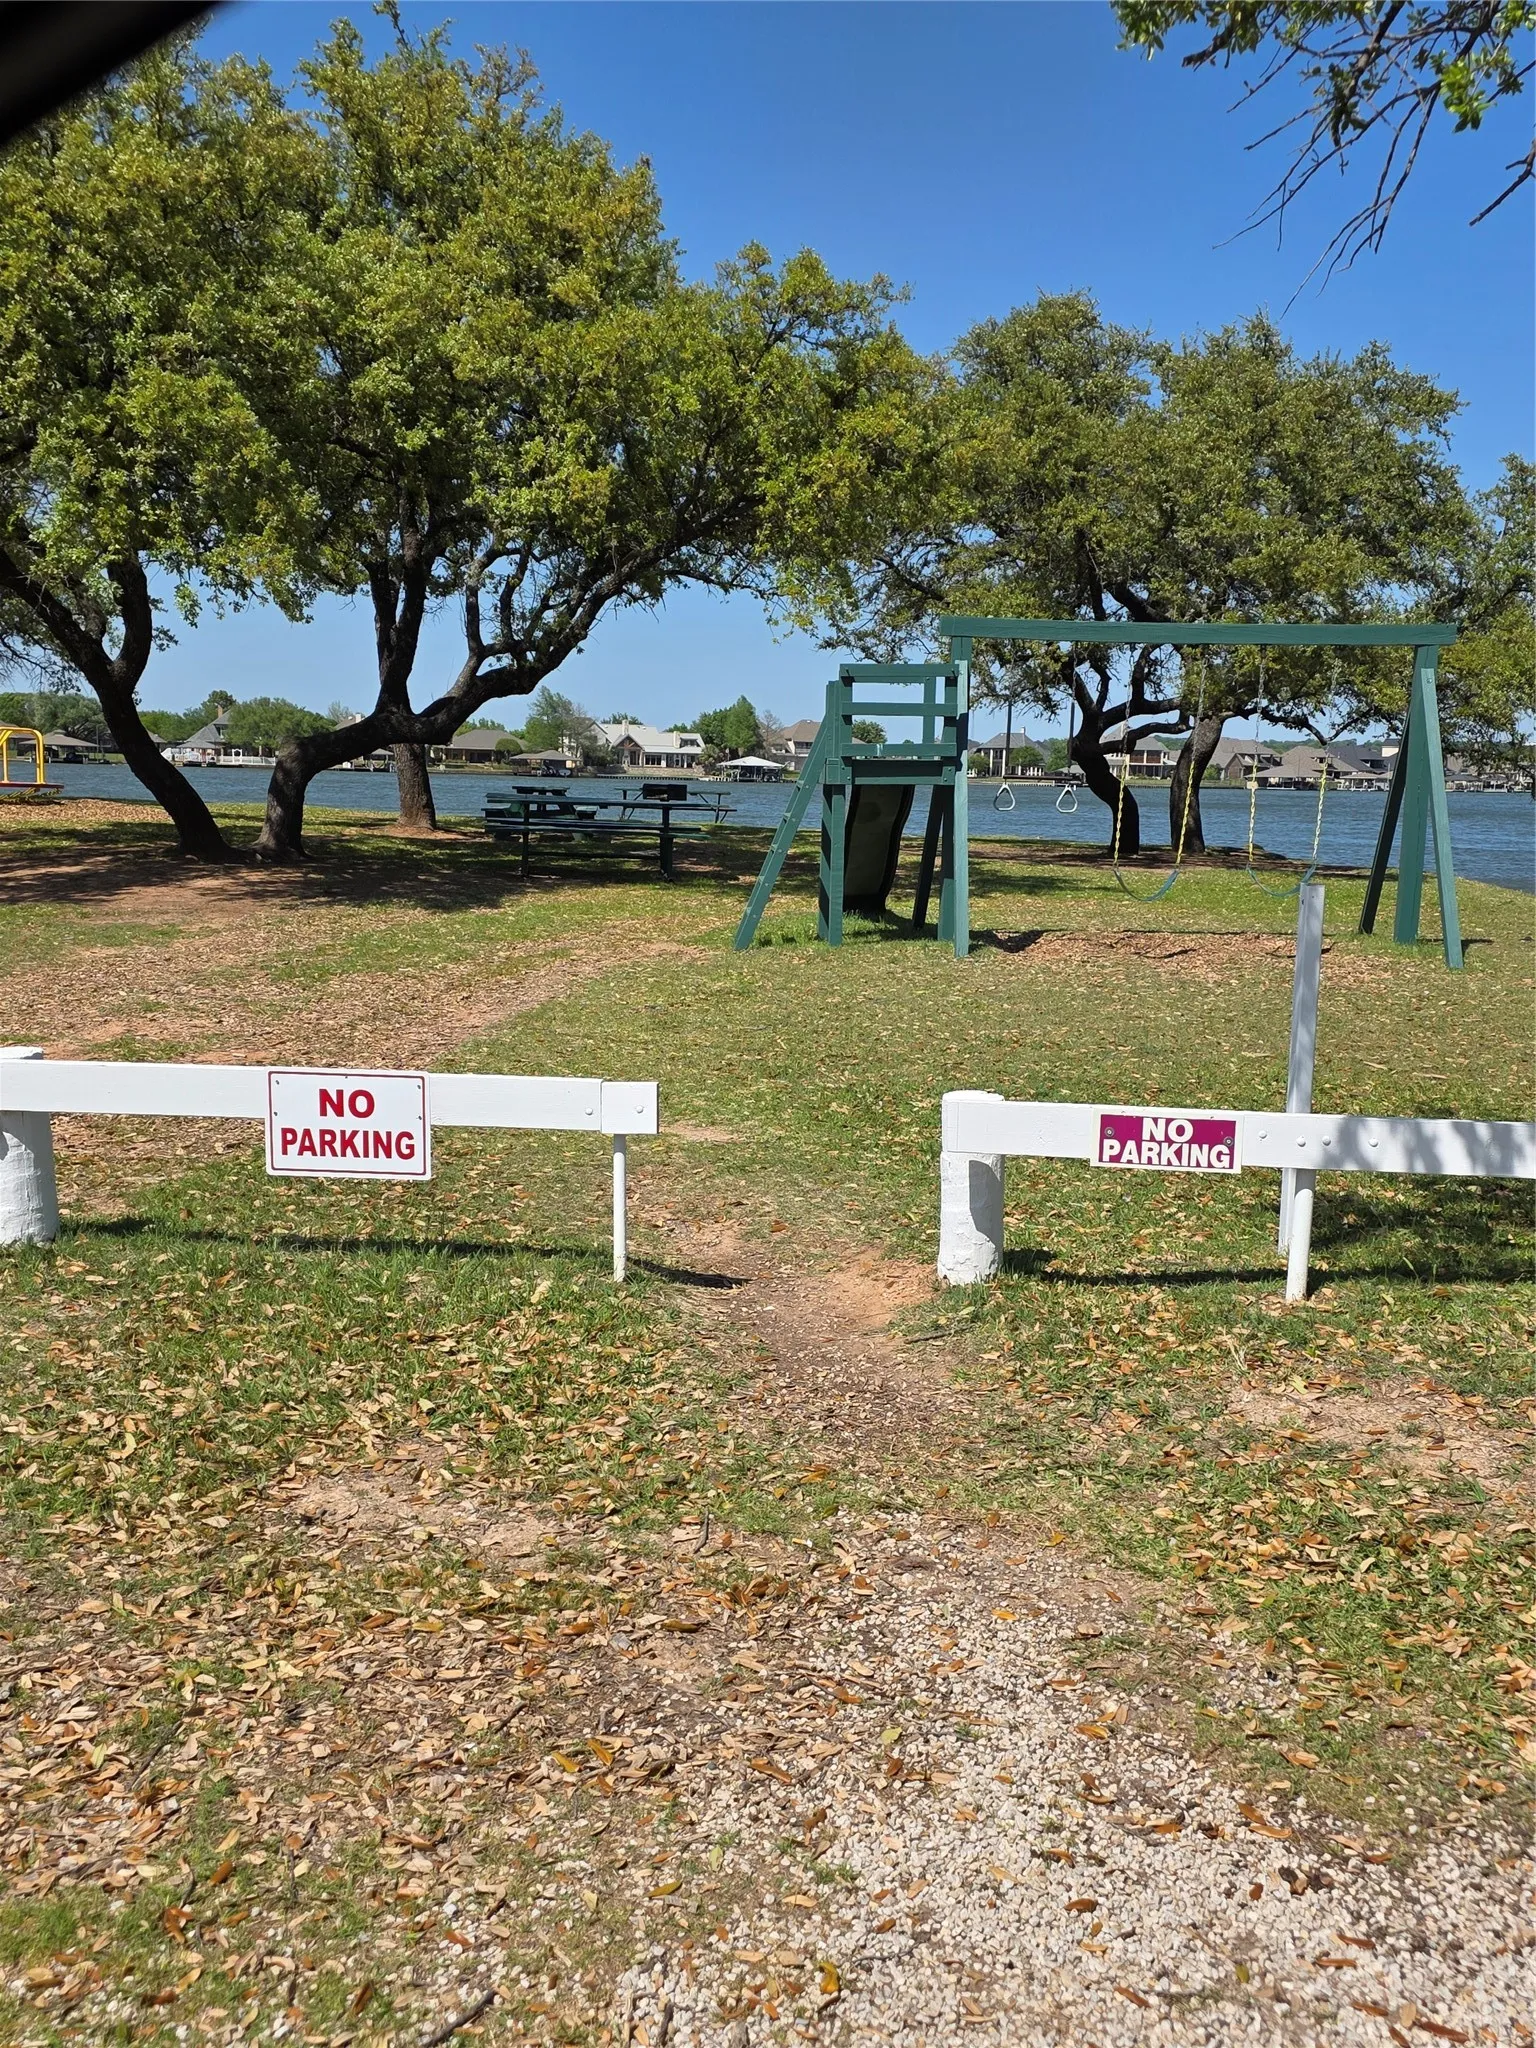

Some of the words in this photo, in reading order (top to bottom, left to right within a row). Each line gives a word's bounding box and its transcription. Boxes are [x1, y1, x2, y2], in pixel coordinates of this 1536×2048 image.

[319, 1089, 375, 1118] NO
[281, 1127, 415, 1160] PARKING
[1142, 1118, 1194, 1142] NO
[1102, 1139, 1231, 1168] PARKING
